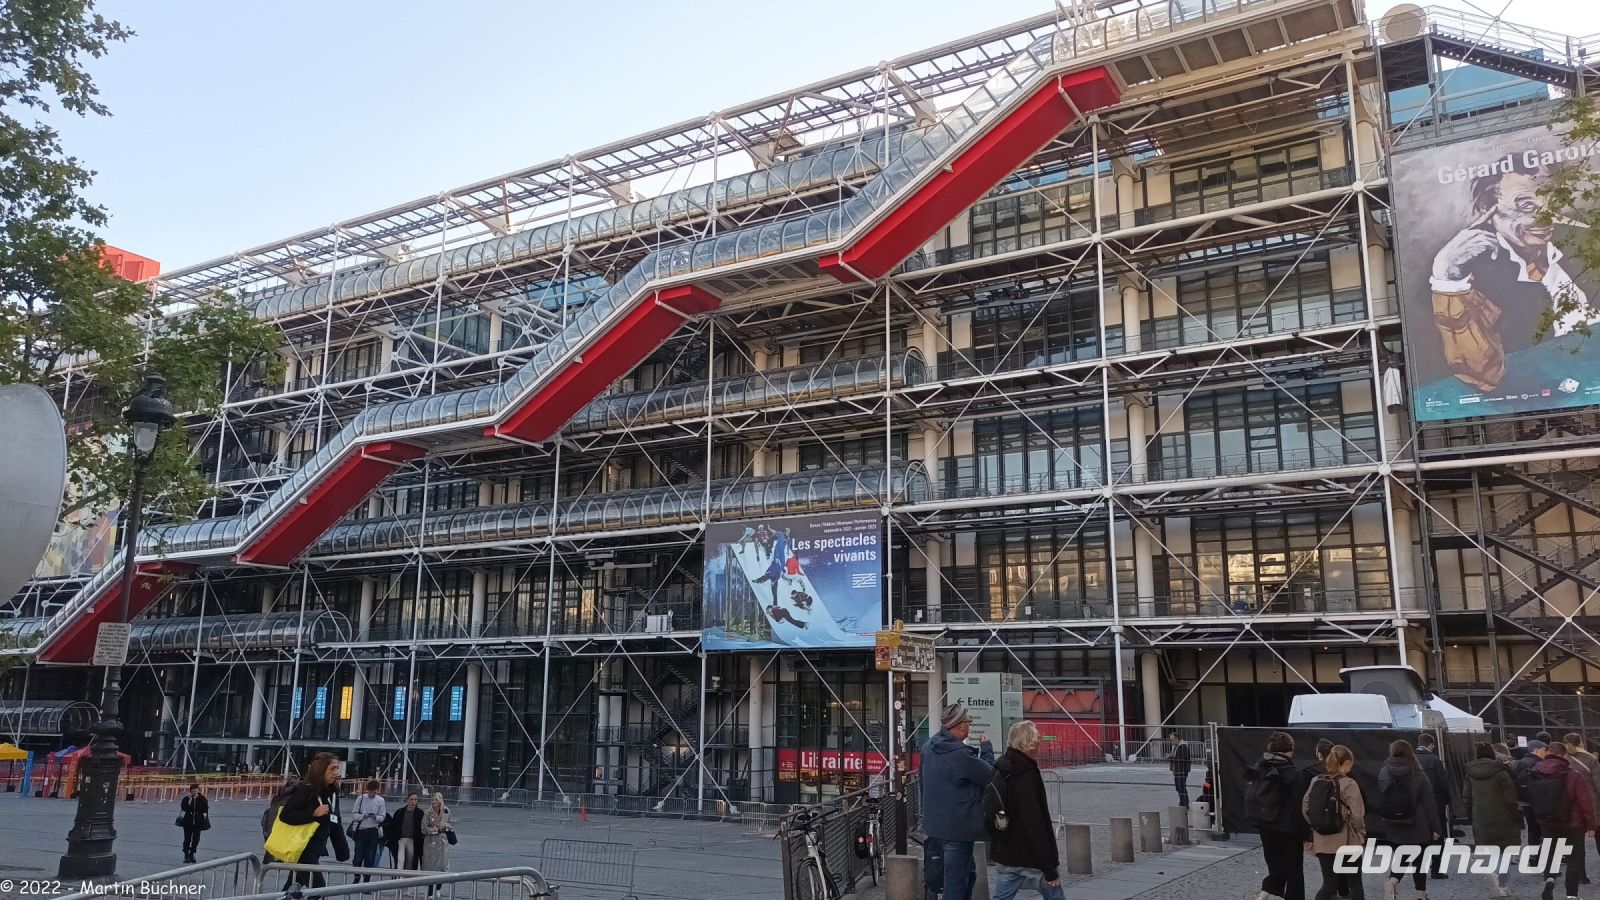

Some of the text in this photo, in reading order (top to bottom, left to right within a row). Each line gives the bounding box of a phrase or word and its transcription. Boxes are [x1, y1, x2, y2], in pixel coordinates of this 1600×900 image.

[1437, 154, 1514, 184] Gérard
[792, 533, 876, 551] Les spectacles
[833, 550, 876, 563] vivants
[967, 697, 995, 707] Entrée
